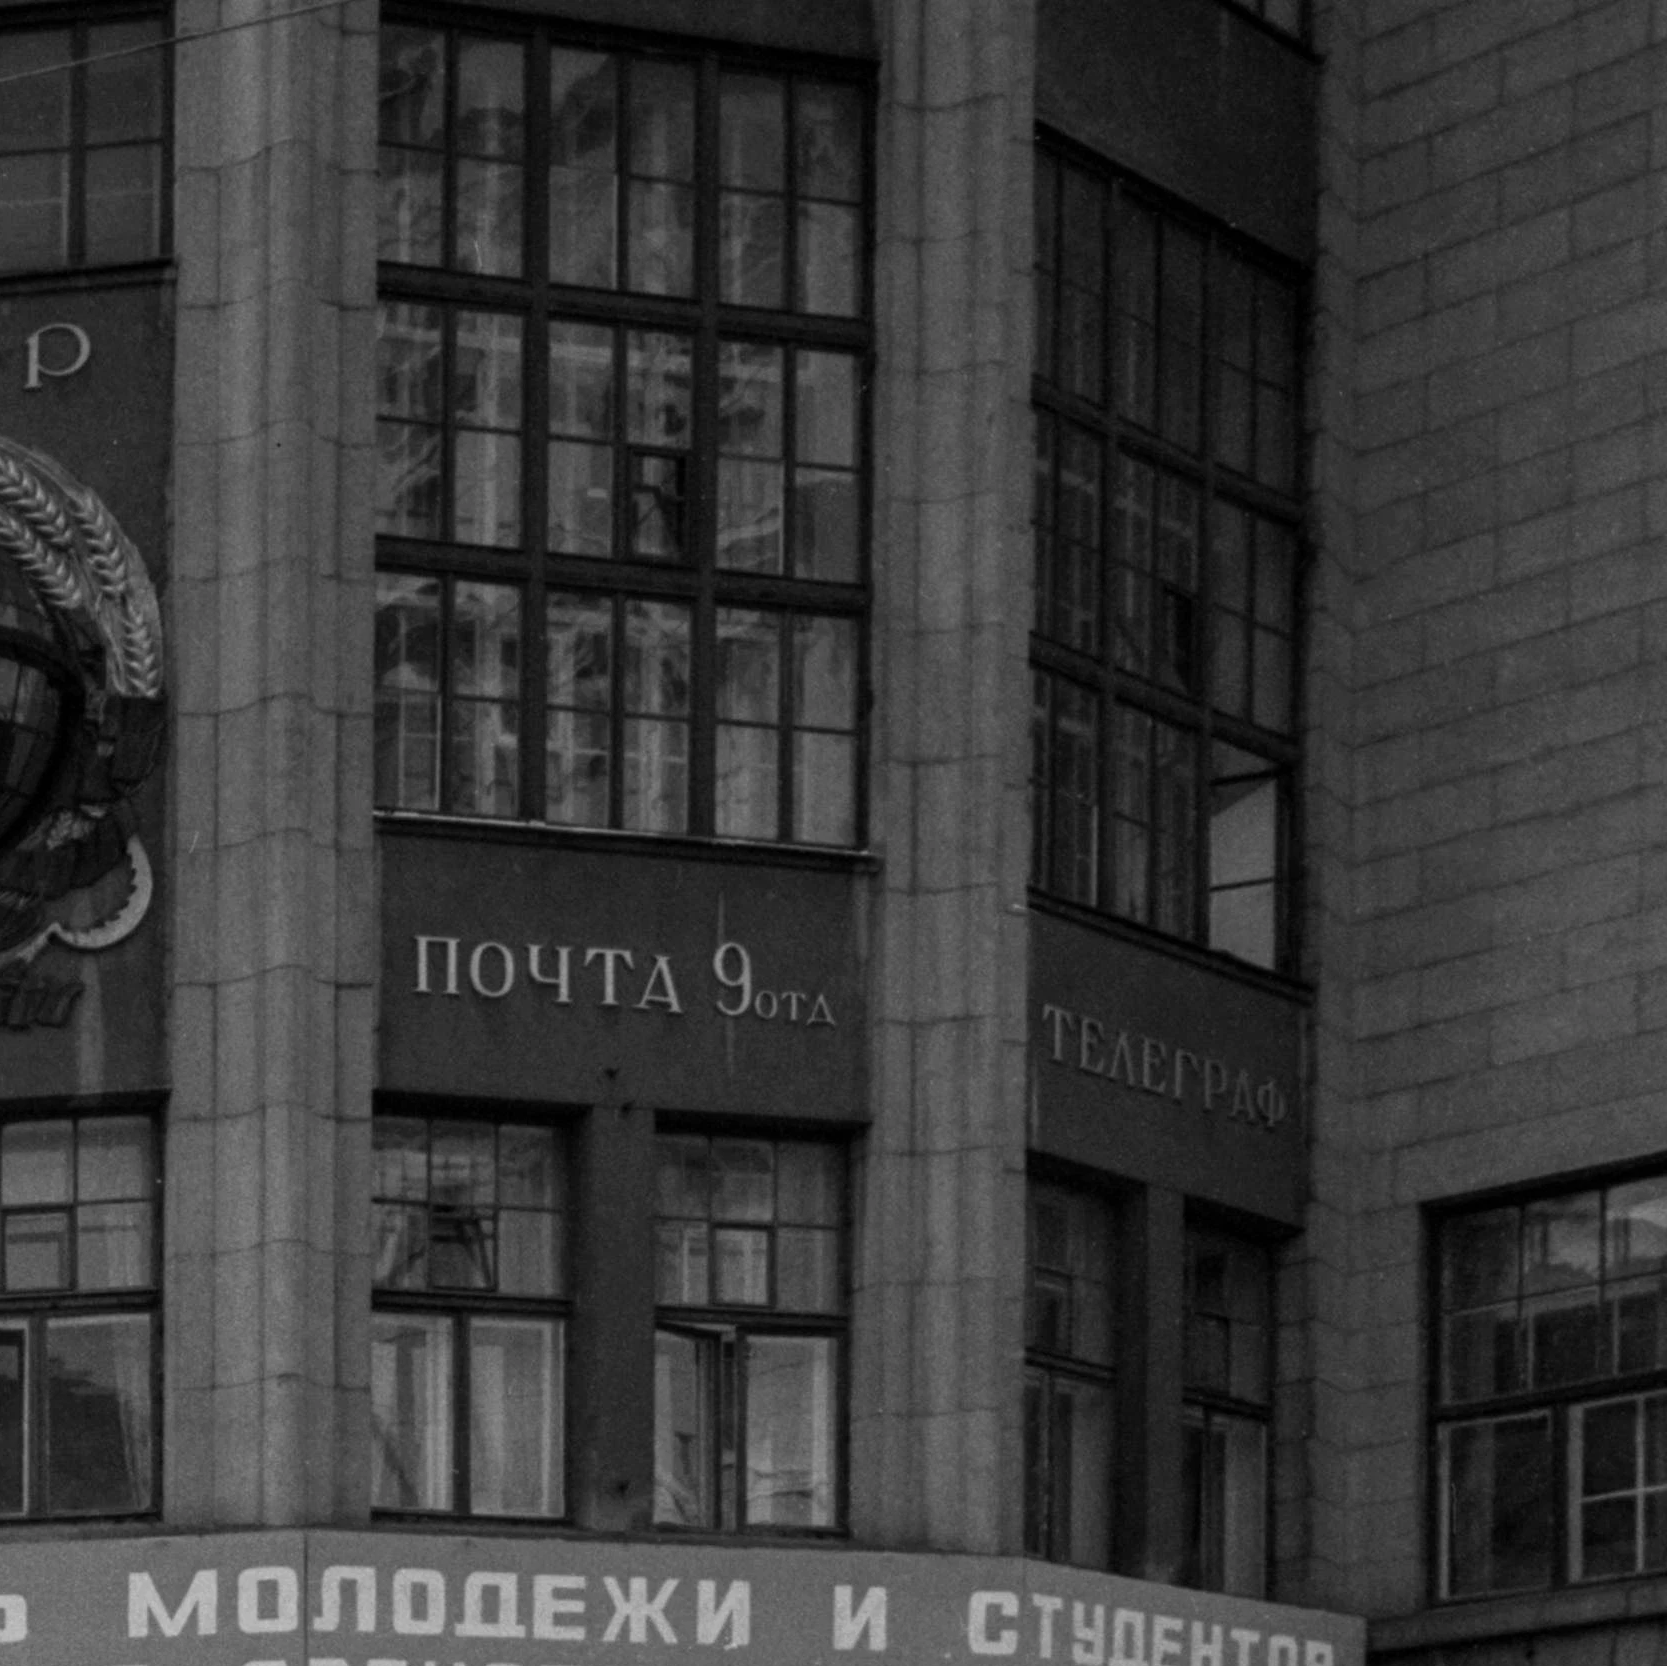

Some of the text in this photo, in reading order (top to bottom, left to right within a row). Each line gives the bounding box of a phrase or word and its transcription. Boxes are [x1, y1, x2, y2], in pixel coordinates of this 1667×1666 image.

[414, 934, 683, 1014] ПОЧТА
[1042, 1003, 1287, 1128] ТЕЛЕГРАФ
[127, 1565, 751, 1645] МОЛОДЕЖИ
[833, 1584, 889, 1652] И
